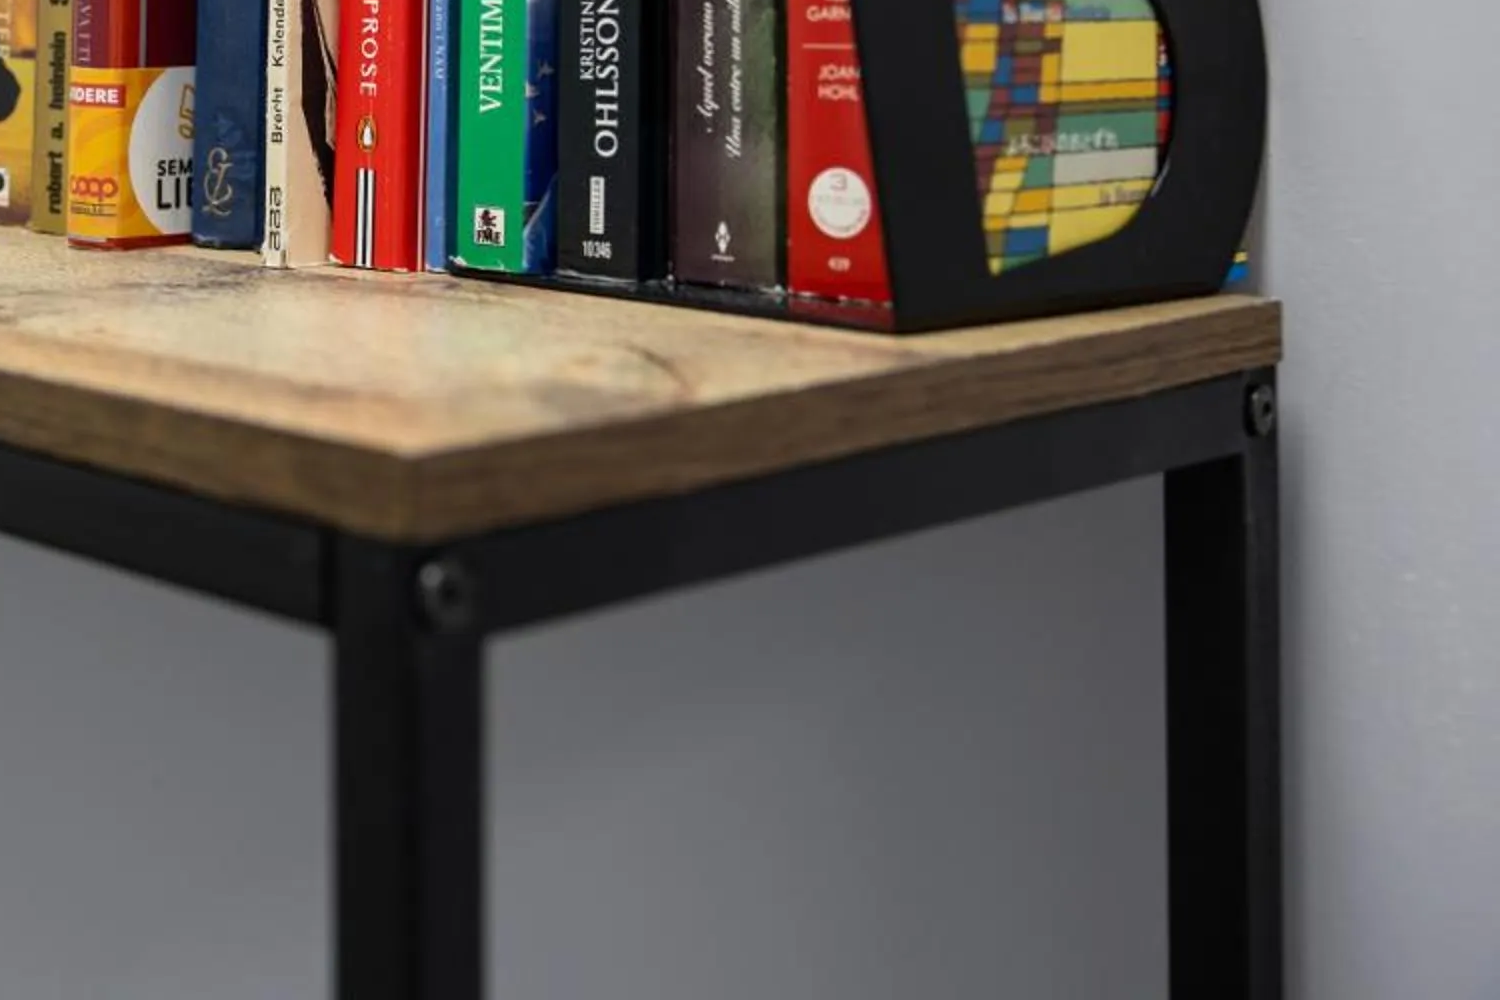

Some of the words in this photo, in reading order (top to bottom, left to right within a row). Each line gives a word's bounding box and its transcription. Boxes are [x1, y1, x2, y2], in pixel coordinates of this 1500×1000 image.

[48, 31, 66, 111] heinlein
[51, 123, 64, 140] a.
[271, 87, 284, 144] Brecht
[47, 151, 65, 215] robert
